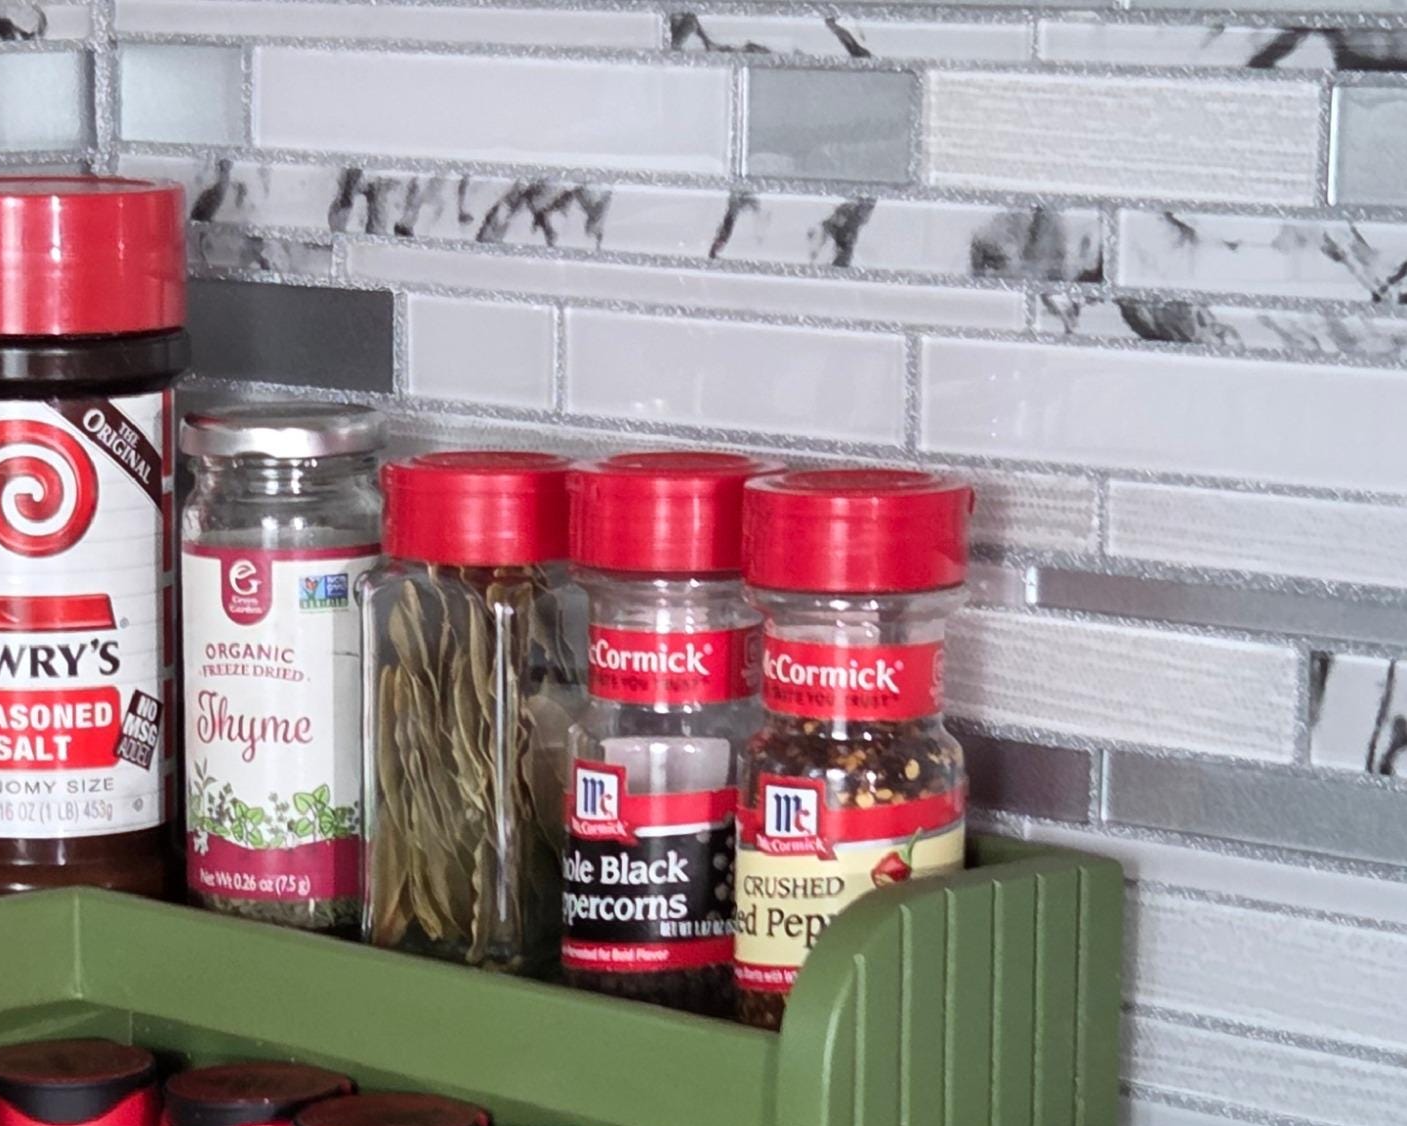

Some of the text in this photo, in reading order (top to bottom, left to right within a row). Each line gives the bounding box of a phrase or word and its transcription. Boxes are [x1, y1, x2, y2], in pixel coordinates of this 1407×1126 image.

[82, 408, 151, 485] ORIGINAL
[119, 421, 140, 448] THE
[205, 643, 295, 664] ORGANIC
[202, 664, 305, 683] FREEZE DRIED
[136, 694, 159, 722] NO
[122, 712, 158, 748] MSG
[196, 689, 314, 764] Thyme
[66, 776, 115, 793] SIZE
[17, 801, 36, 822] OZ
[57, 801, 80, 824] LB)
[84, 799, 113, 822] 453g
[600, 850, 690, 885] Black
[743, 875, 845, 899] CRUSHED
